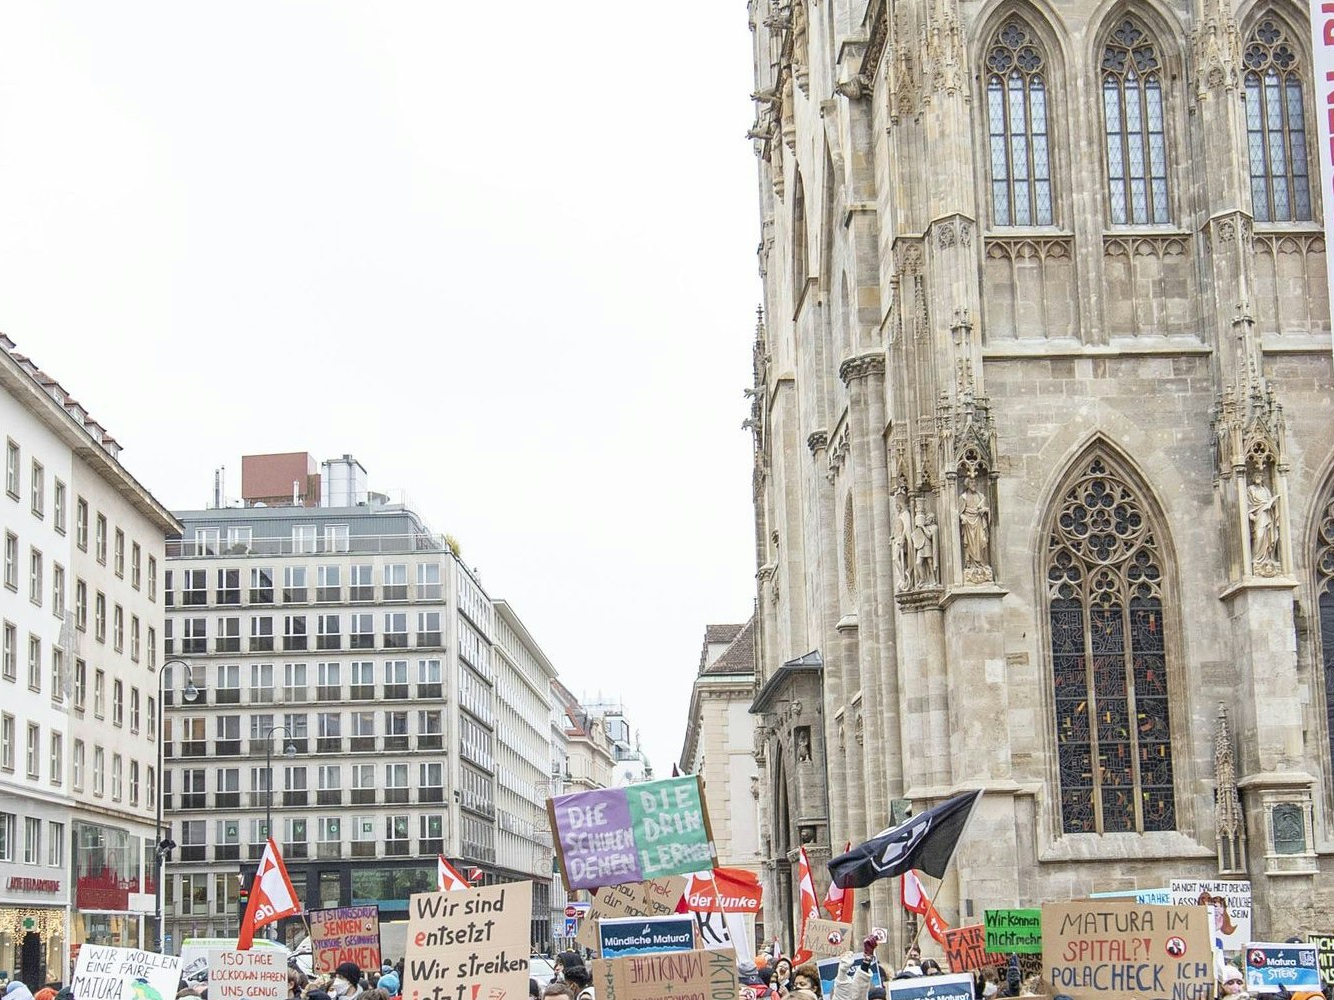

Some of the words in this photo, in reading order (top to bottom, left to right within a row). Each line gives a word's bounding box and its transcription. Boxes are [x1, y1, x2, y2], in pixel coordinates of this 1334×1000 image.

[640, 784, 693, 813] DIE
[567, 802, 608, 829] DIE
[417, 896, 459, 919] Wir
[464, 889, 505, 915] sind
[689, 893, 713, 907] der
[985, 910, 1005, 928] Wir
[1230, 909, 1249, 918] SEIN
[323, 920, 362, 937] SENKEN
[1060, 910, 1154, 936] MATURA
[1167, 910, 1189, 931] IM
[414, 919, 495, 947] entsetzt
[604, 936, 651, 946] Mündliche
[653, 933, 690, 945] Matura?
[987, 931, 1017, 946] nicht
[1017, 934, 1042, 946] mehr
[1063, 938, 1151, 962] SPITAL?!
[89, 949, 117, 962] WIR
[126, 951, 180, 971] WOLLEN
[220, 952, 244, 966] 150
[248, 954, 273, 966] TAGE
[411, 959, 450, 981] Wir
[457, 951, 529, 978] streiken
[1267, 958, 1297, 966] Matura
[86, 962, 112, 974] EINE
[119, 964, 154, 979] FAIRE
[212, 970, 258, 981] LOCKDOWN
[261, 972, 286, 982] HABEN
[1051, 964, 1165, 993] POLACHECK
[1178, 963, 1207, 979] ICH
[74, 976, 124, 1000] MATURA
[221, 986, 244, 997] UNS
[247, 986, 278, 997] GENUG
[1173, 983, 1214, 1000] NICHT
